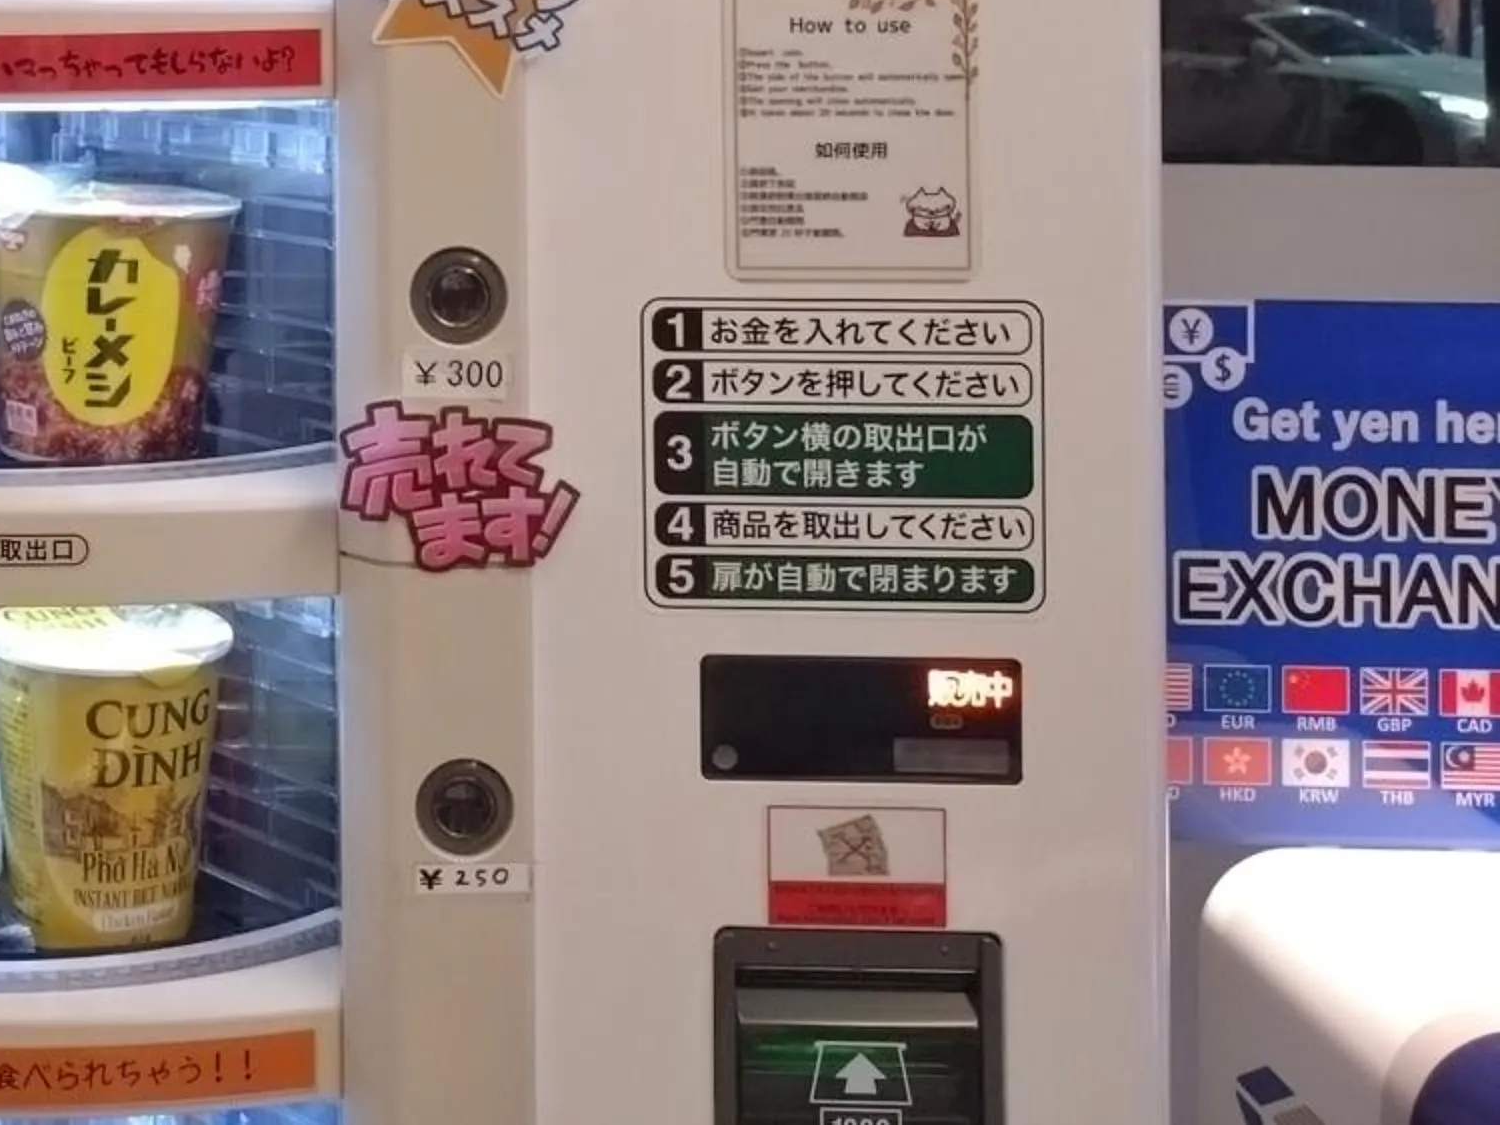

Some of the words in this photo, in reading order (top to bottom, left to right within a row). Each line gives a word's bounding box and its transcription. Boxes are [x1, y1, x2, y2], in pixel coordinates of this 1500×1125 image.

[789, 17, 833, 34] How
[845, 18, 866, 33] to
[876, 19, 912, 34] use
[815, 142, 888, 160] 如何使用
[84, 249, 139, 408] カレーメシ
[667, 312, 685, 348] 1
[711, 316, 1011, 346] お金を入れてください
[62, 337, 78, 384] ビーフ
[665, 364, 693, 399] 2
[711, 369, 1019, 399] ボタンを押してください
[1233, 396, 1321, 442] Get
[1332, 409, 1419, 451] yen
[1436, 399, 1500, 444] he
[340, 399, 554, 522] 売れて
[666, 435, 693, 471] 3
[711, 421, 987, 454] ボタン横の取出口が
[712, 458, 925, 489] 自動で開きます
[411, 478, 582, 573] ます!
[667, 507, 694, 542] 4
[713, 510, 1026, 541] 商品を取出してください
[0, 540, 74, 562] 取出口
[668, 558, 695, 594] 5
[712, 561, 1017, 595] 扉が自動で閉まります
[1173, 550, 1500, 630] EXCHAN
[85, 687, 212, 742] CUNG
[1221, 714, 1255, 730] EUR
[1297, 716, 1338, 732] RMB
[1377, 718, 1413, 732] GBP
[1457, 719, 1493, 734] CAD
[1220, 787, 1256, 802] HKD
[1299, 789, 1339, 804] KRW
[1379, 790, 1415, 806] THB
[1455, 792, 1495, 808] MYR
